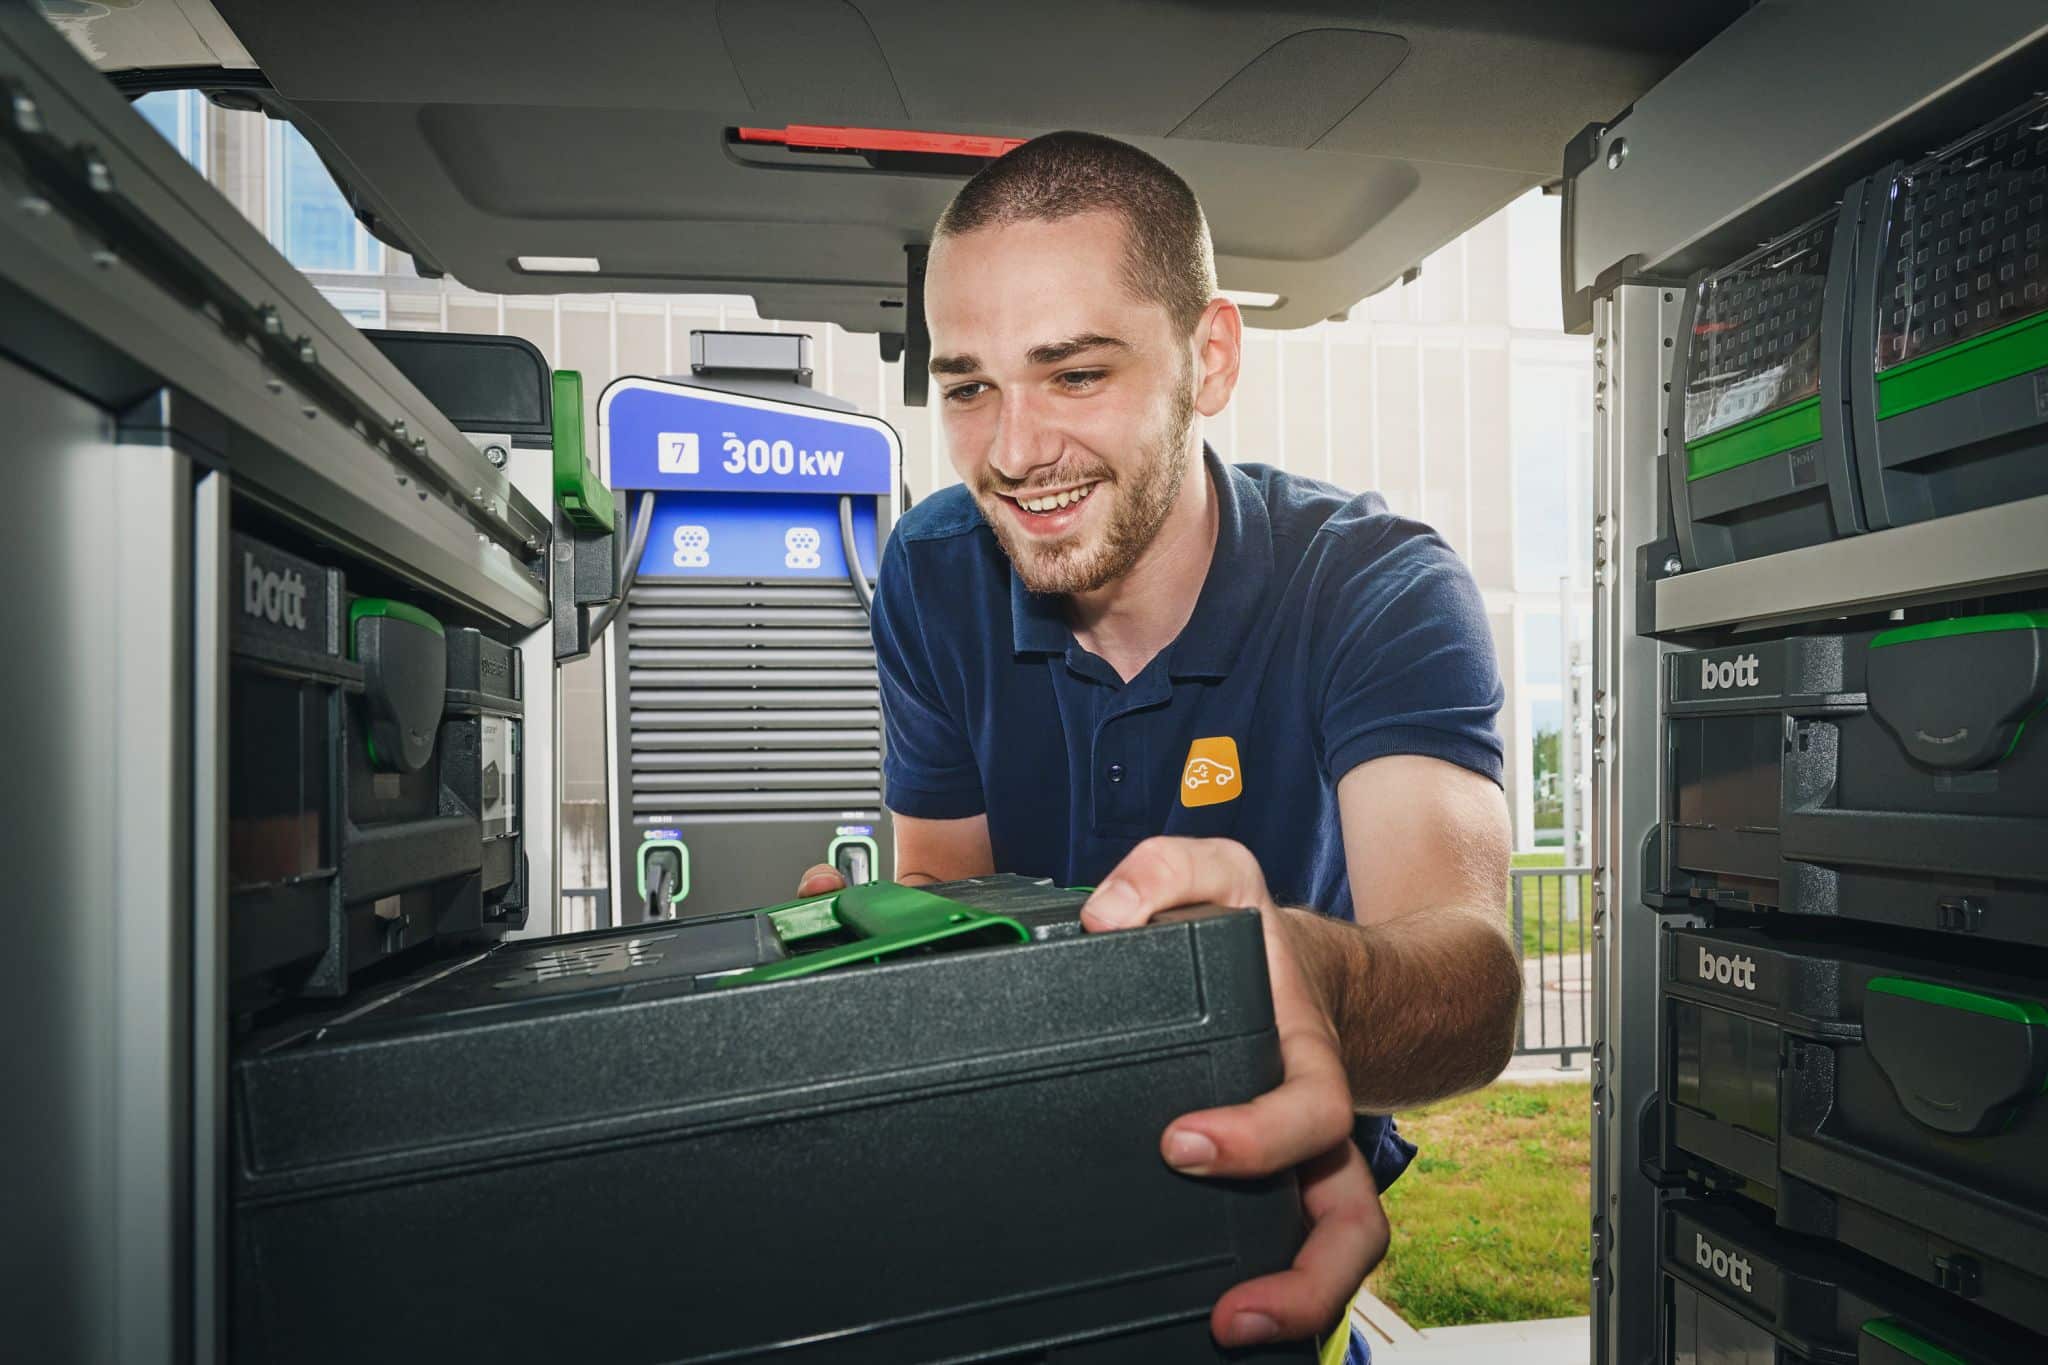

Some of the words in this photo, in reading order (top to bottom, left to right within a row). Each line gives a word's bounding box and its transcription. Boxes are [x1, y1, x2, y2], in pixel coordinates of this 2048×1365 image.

[672, 442, 686, 463] 7
[722, 439, 794, 475] 300
[799, 450, 845, 477] kW
[244, 552, 307, 632] bott
[1701, 653, 1760, 691] bott
[1698, 947, 1757, 991] bott
[1695, 1232, 1753, 1295] bott
